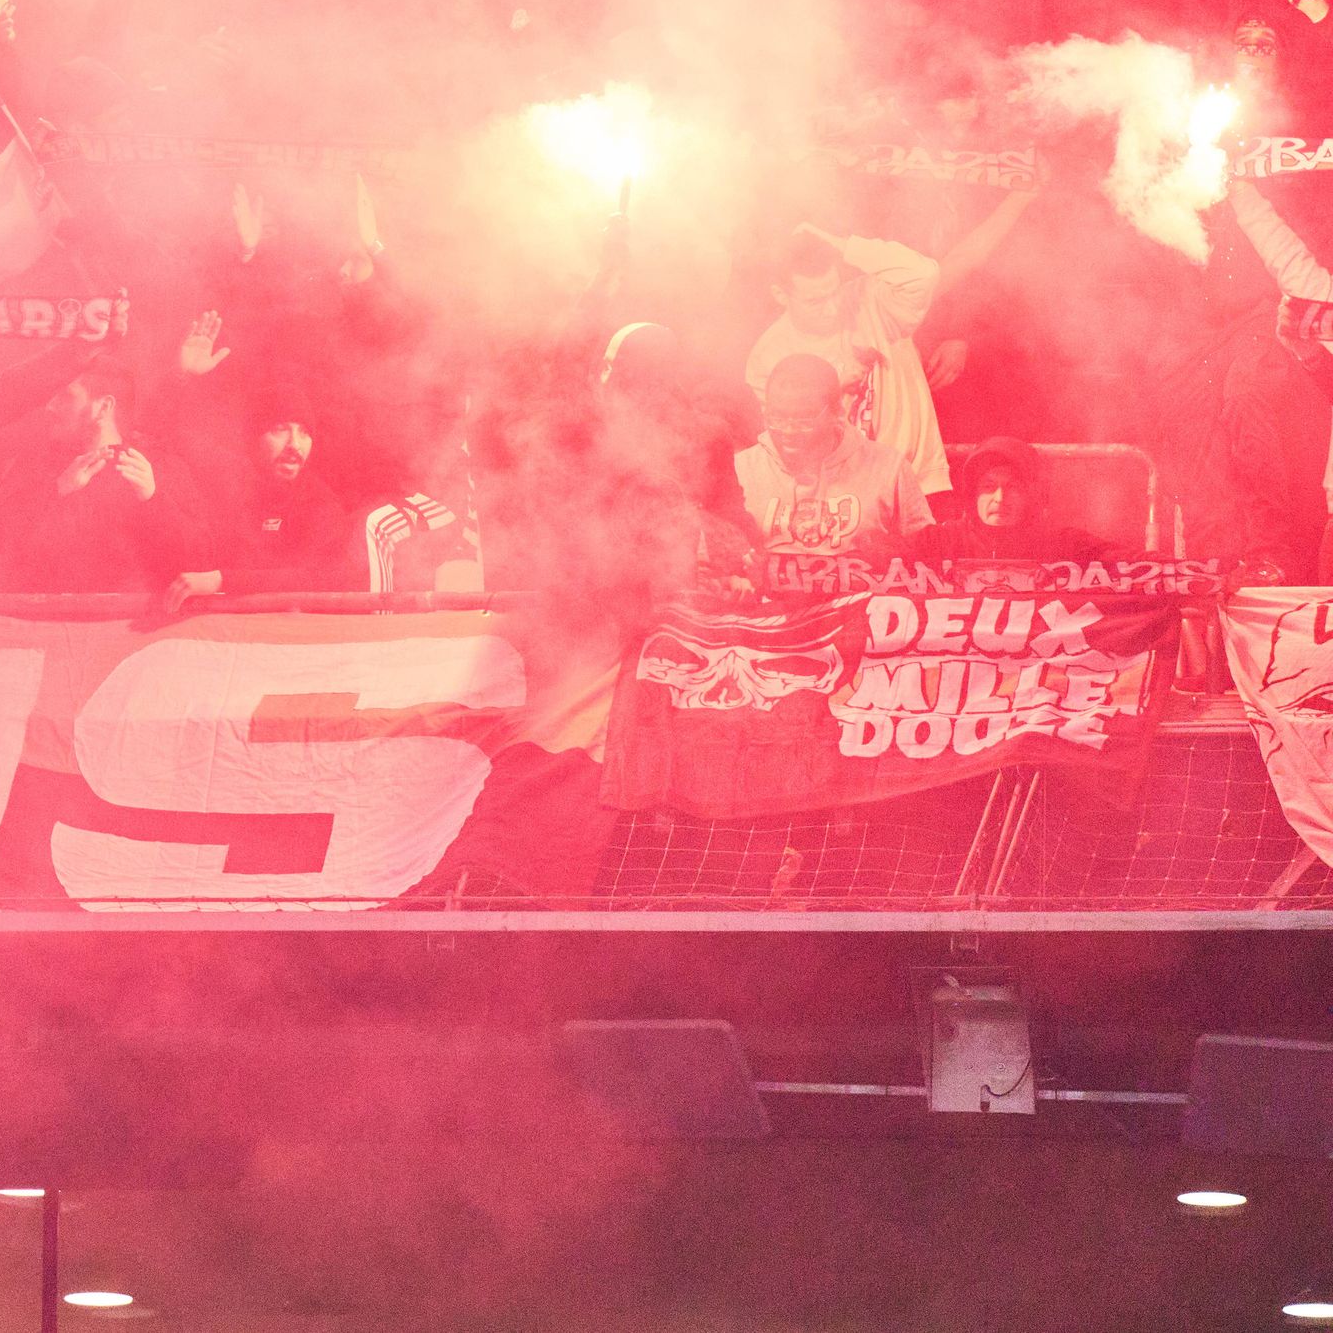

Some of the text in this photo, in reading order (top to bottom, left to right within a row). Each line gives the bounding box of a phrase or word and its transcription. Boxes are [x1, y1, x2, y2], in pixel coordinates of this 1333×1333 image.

[768, 555, 955, 595] URBAN
[863, 595, 1105, 659] DEUX
[844, 661, 1122, 717] MILLE
[837, 706, 1111, 760] DOUZE
